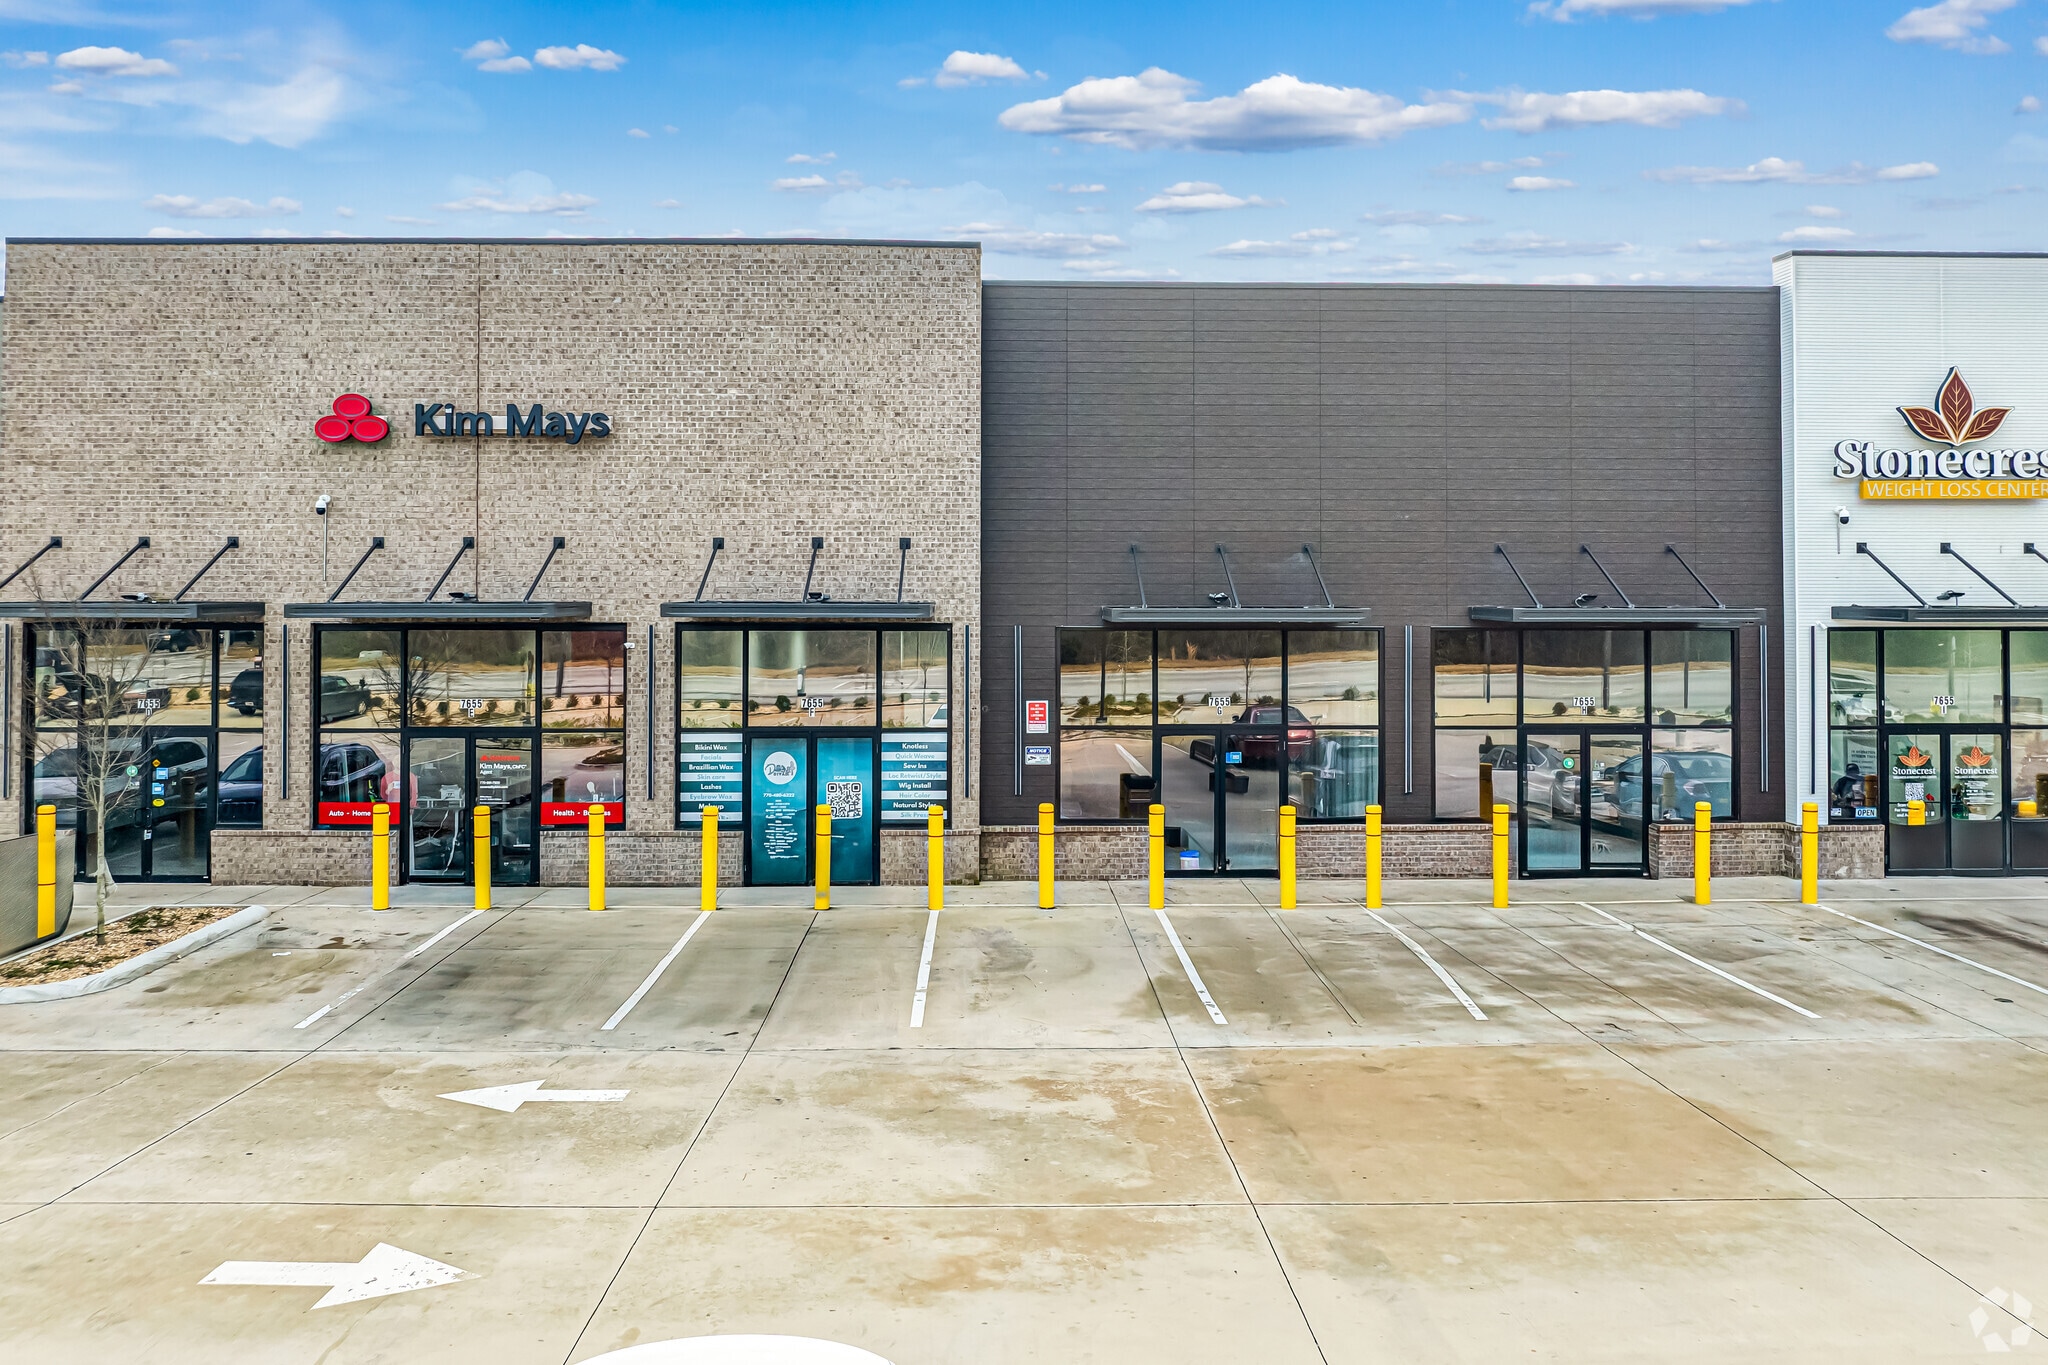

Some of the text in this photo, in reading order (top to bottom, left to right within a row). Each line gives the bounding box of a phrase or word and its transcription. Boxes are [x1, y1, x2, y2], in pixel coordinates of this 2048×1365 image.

[415, 403, 611, 445] Kim Mays
[1866, 482, 2048, 497] WEIGHT LOSS CENTER
[138, 699, 160, 708] 7655
[461, 699, 483, 708] 7655
[802, 698, 823, 708] 7655
[1210, 697, 1230, 706] 7655
[1574, 697, 1595, 706] 7655
[1934, 696, 1954, 705] 7655
[469, 709, 474, 717] E
[810, 708, 815, 717] F
[1217, 706, 1222, 715] G
[1582, 706, 1587, 715] H
[1892, 766, 1937, 775] Stonecrest
[1954, 766, 1998, 775] Stonecrest
[1857, 809, 1875, 817] OPEN
